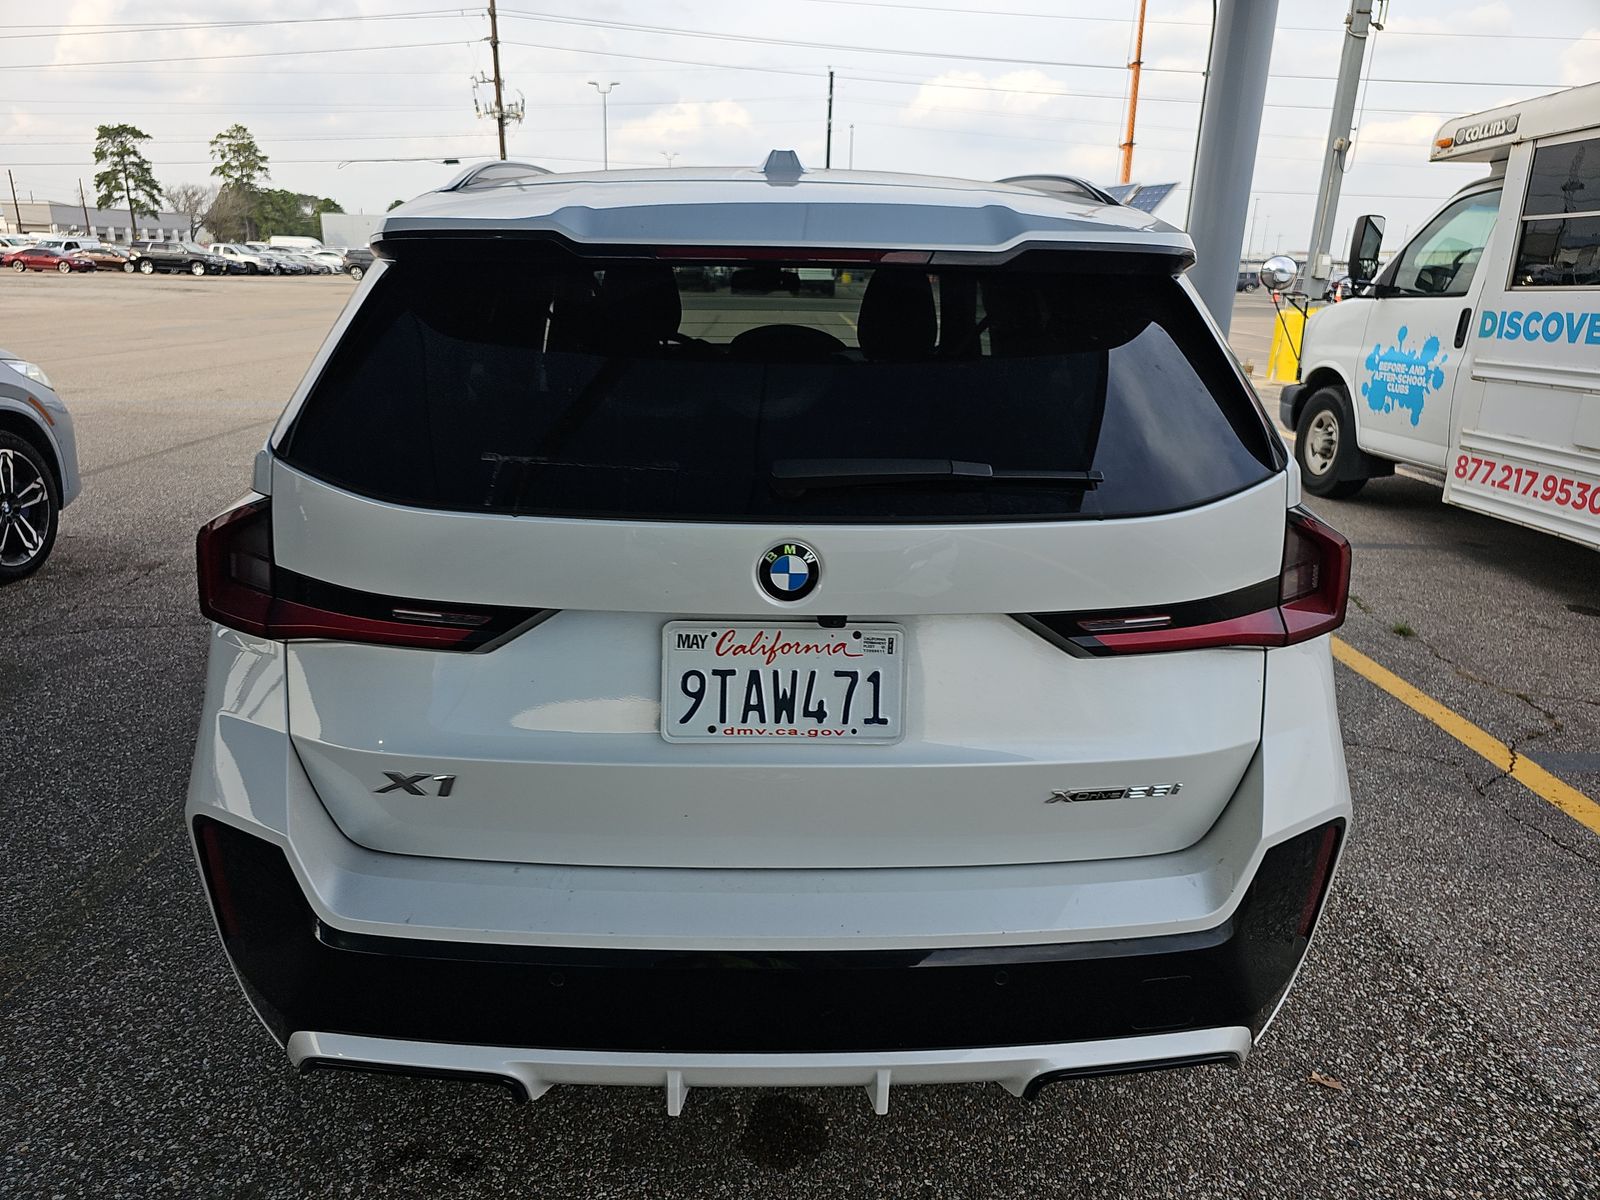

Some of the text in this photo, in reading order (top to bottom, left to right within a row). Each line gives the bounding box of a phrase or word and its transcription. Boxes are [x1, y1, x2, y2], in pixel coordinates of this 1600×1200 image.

[1465, 119, 1506, 142] COLLINS
[1478, 310, 1600, 345] DISCOVE
[1408, 364, 1426, 376] AND
[1387, 382, 1410, 395] CLUBS
[765, 544, 816, 564] BMW
[677, 633, 709, 650] MAY
[715, 629, 864, 665] California
[679, 669, 889, 726] 9TAW471
[723, 726, 846, 738] dmv.ca.gov
[372, 769, 457, 797] X1
